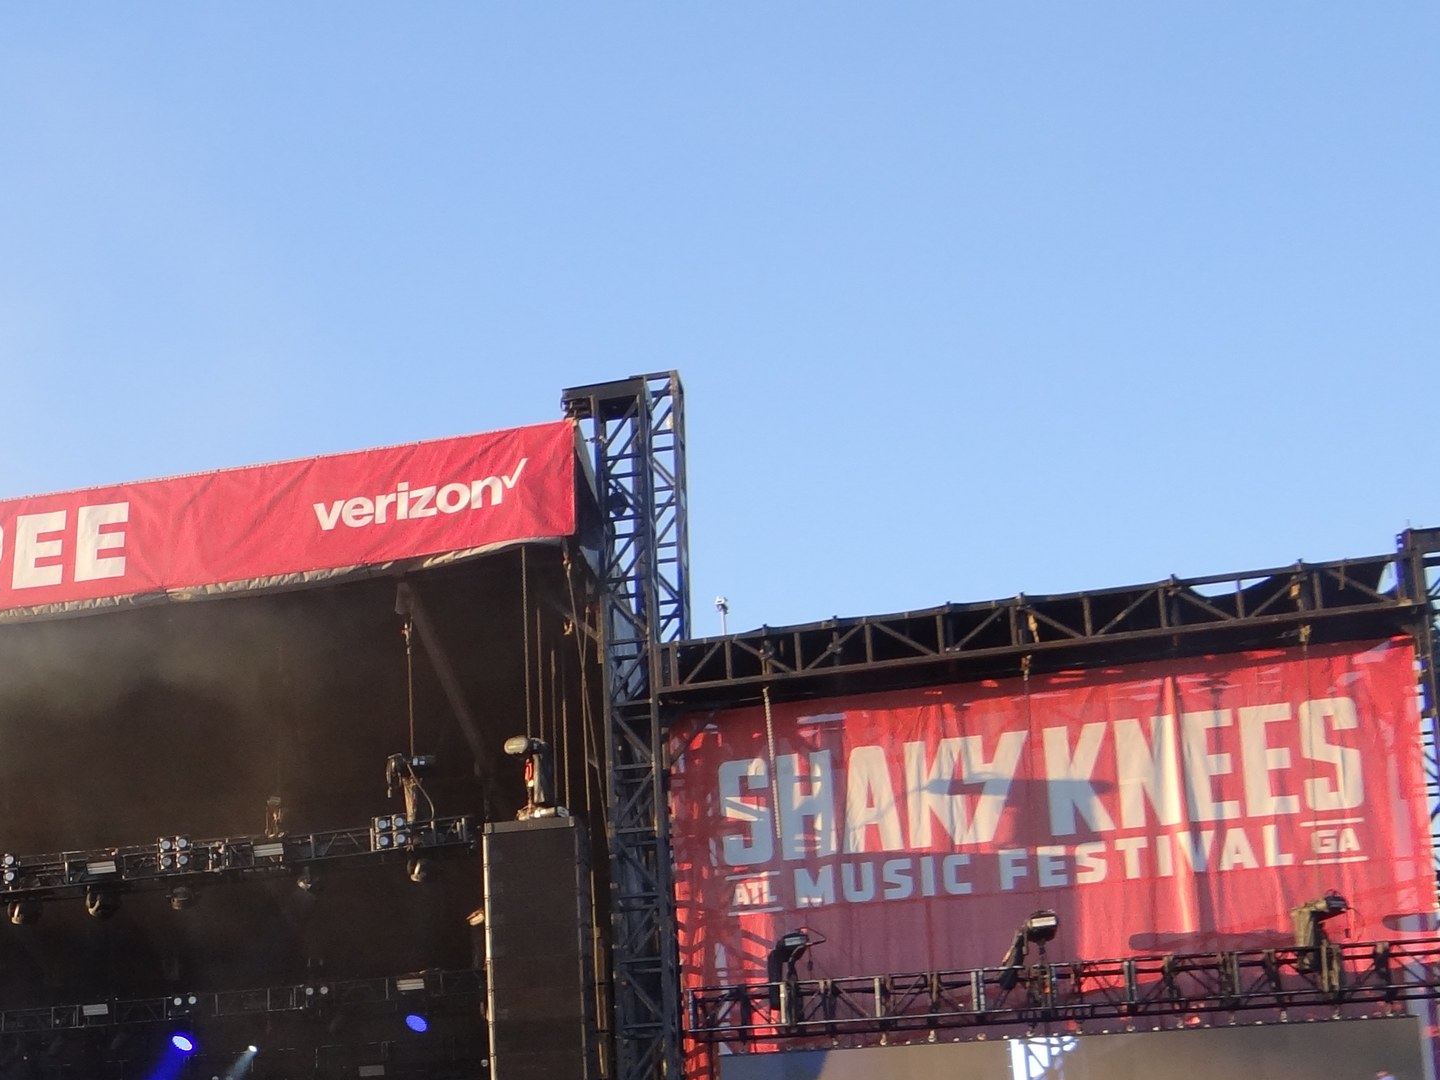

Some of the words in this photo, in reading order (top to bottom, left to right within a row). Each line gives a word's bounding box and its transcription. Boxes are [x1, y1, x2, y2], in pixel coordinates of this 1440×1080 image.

[313, 475, 503, 531] verizon
[718, 730, 1029, 866] SHAKY
[1042, 696, 1365, 836] KNEES
[731, 880, 778, 907] ATL
[793, 853, 973, 909] MUSIC
[998, 824, 1294, 890] FESTIVAL
[1310, 827, 1361, 854] GA
